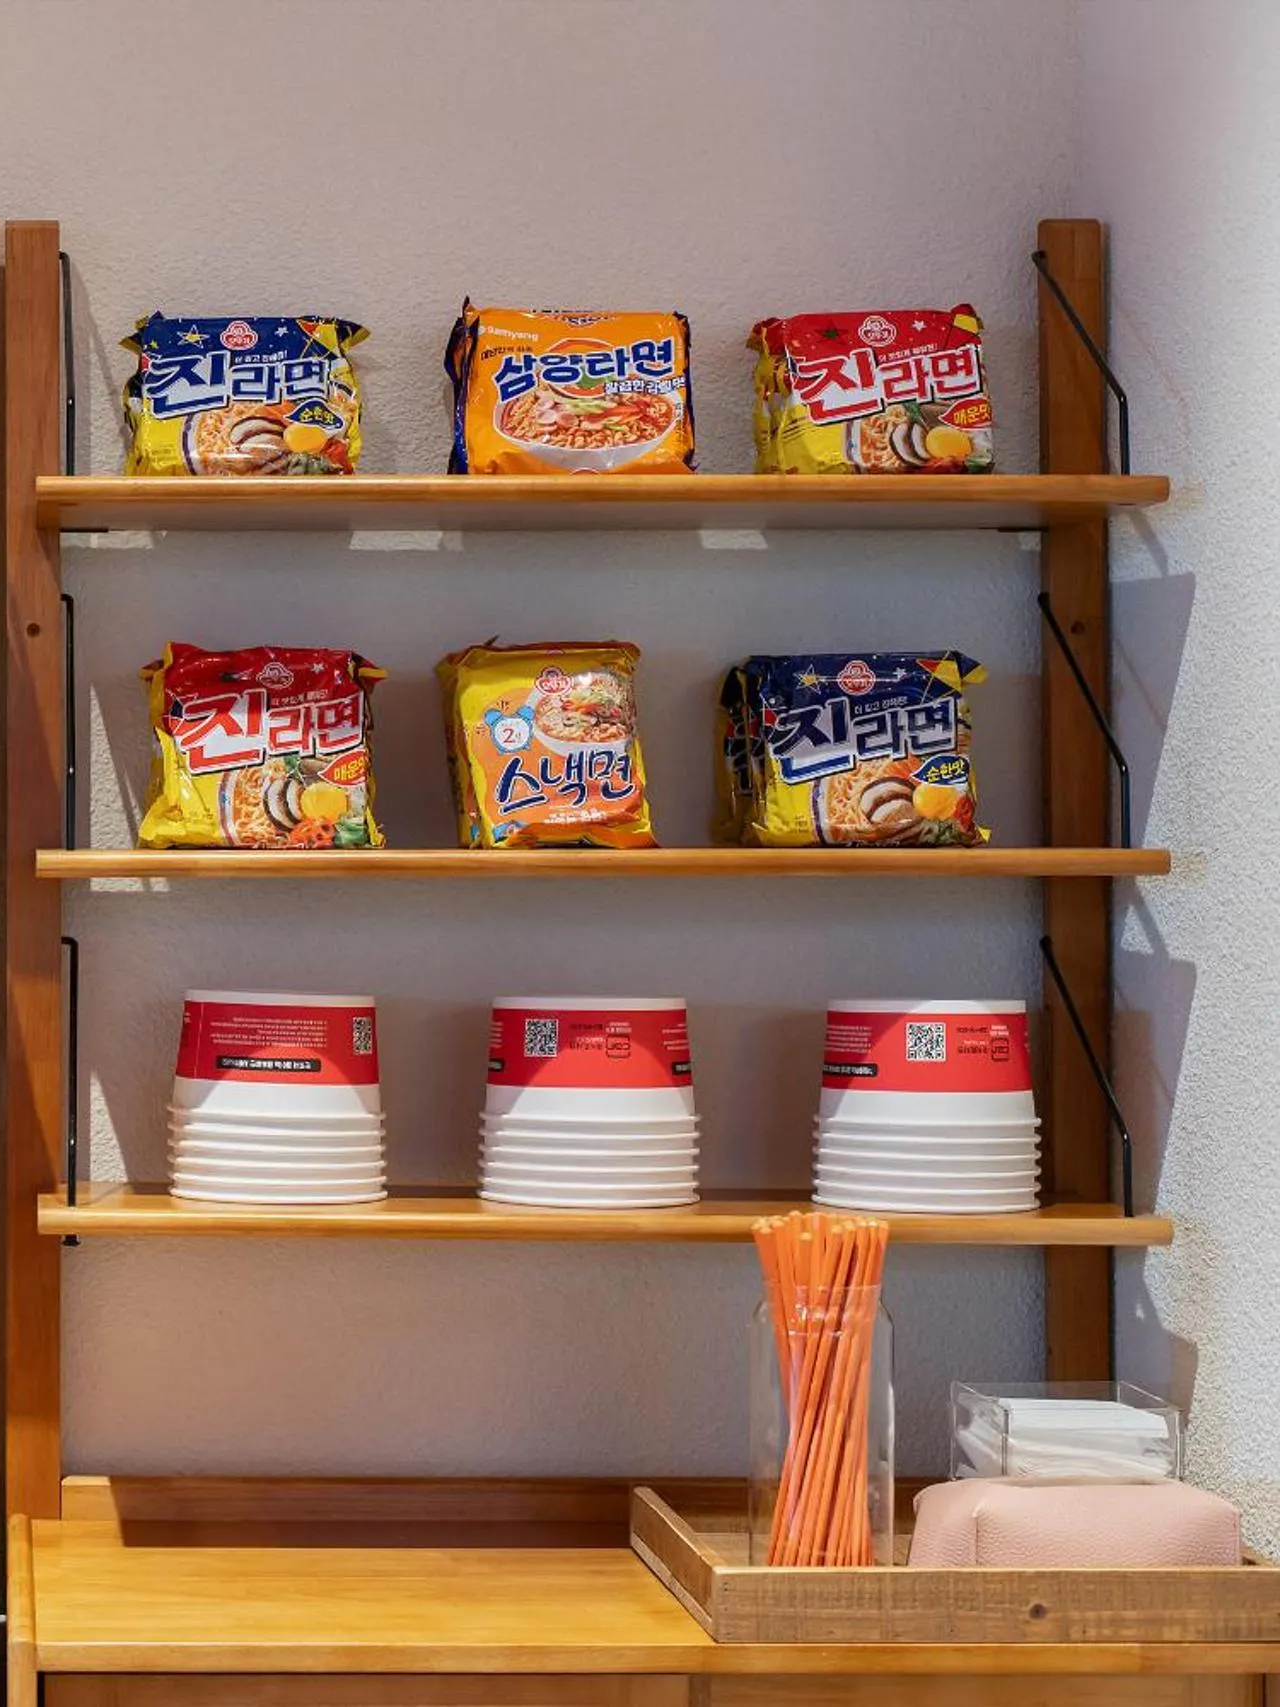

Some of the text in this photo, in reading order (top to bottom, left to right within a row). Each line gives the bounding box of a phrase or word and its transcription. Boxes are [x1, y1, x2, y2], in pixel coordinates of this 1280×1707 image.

[143, 351, 330, 419] 진라면
[493, 337, 674, 402] 삼양라면
[792, 344, 982, 424] 진라면
[173, 689, 365, 775] 진라면
[770, 696, 958, 785] 진라면
[497, 751, 634, 817] 스낵면
[927, 759, 965, 783] 순한맛
